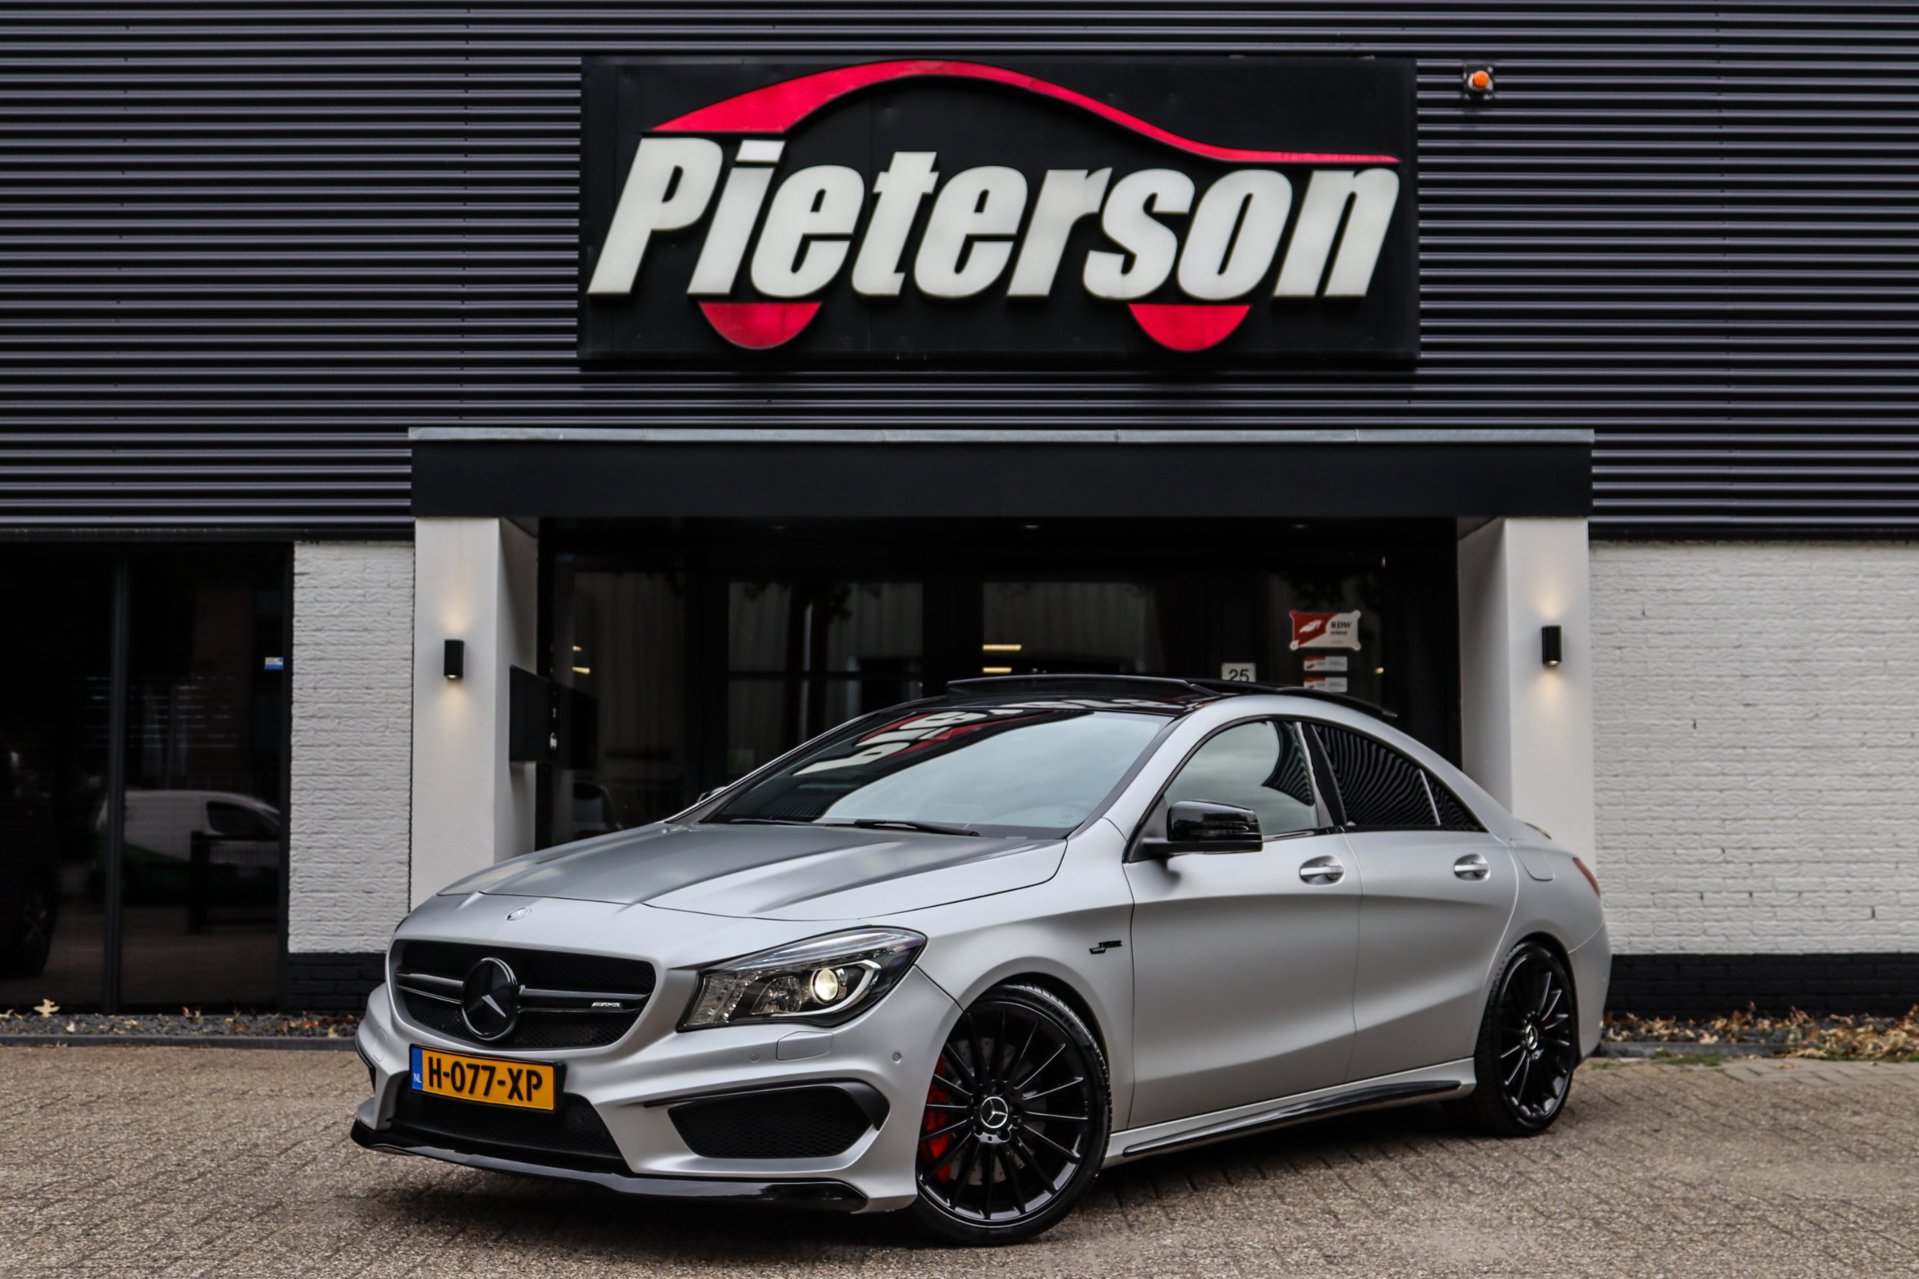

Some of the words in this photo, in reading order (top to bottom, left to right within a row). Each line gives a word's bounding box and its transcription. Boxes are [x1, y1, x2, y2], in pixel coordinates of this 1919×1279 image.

[587, 138, 1400, 300] Pieterson
[1229, 669, 1250, 682] 25
[413, 1073, 422, 1083] NL
[428, 1056, 543, 1102] H-077-XP
